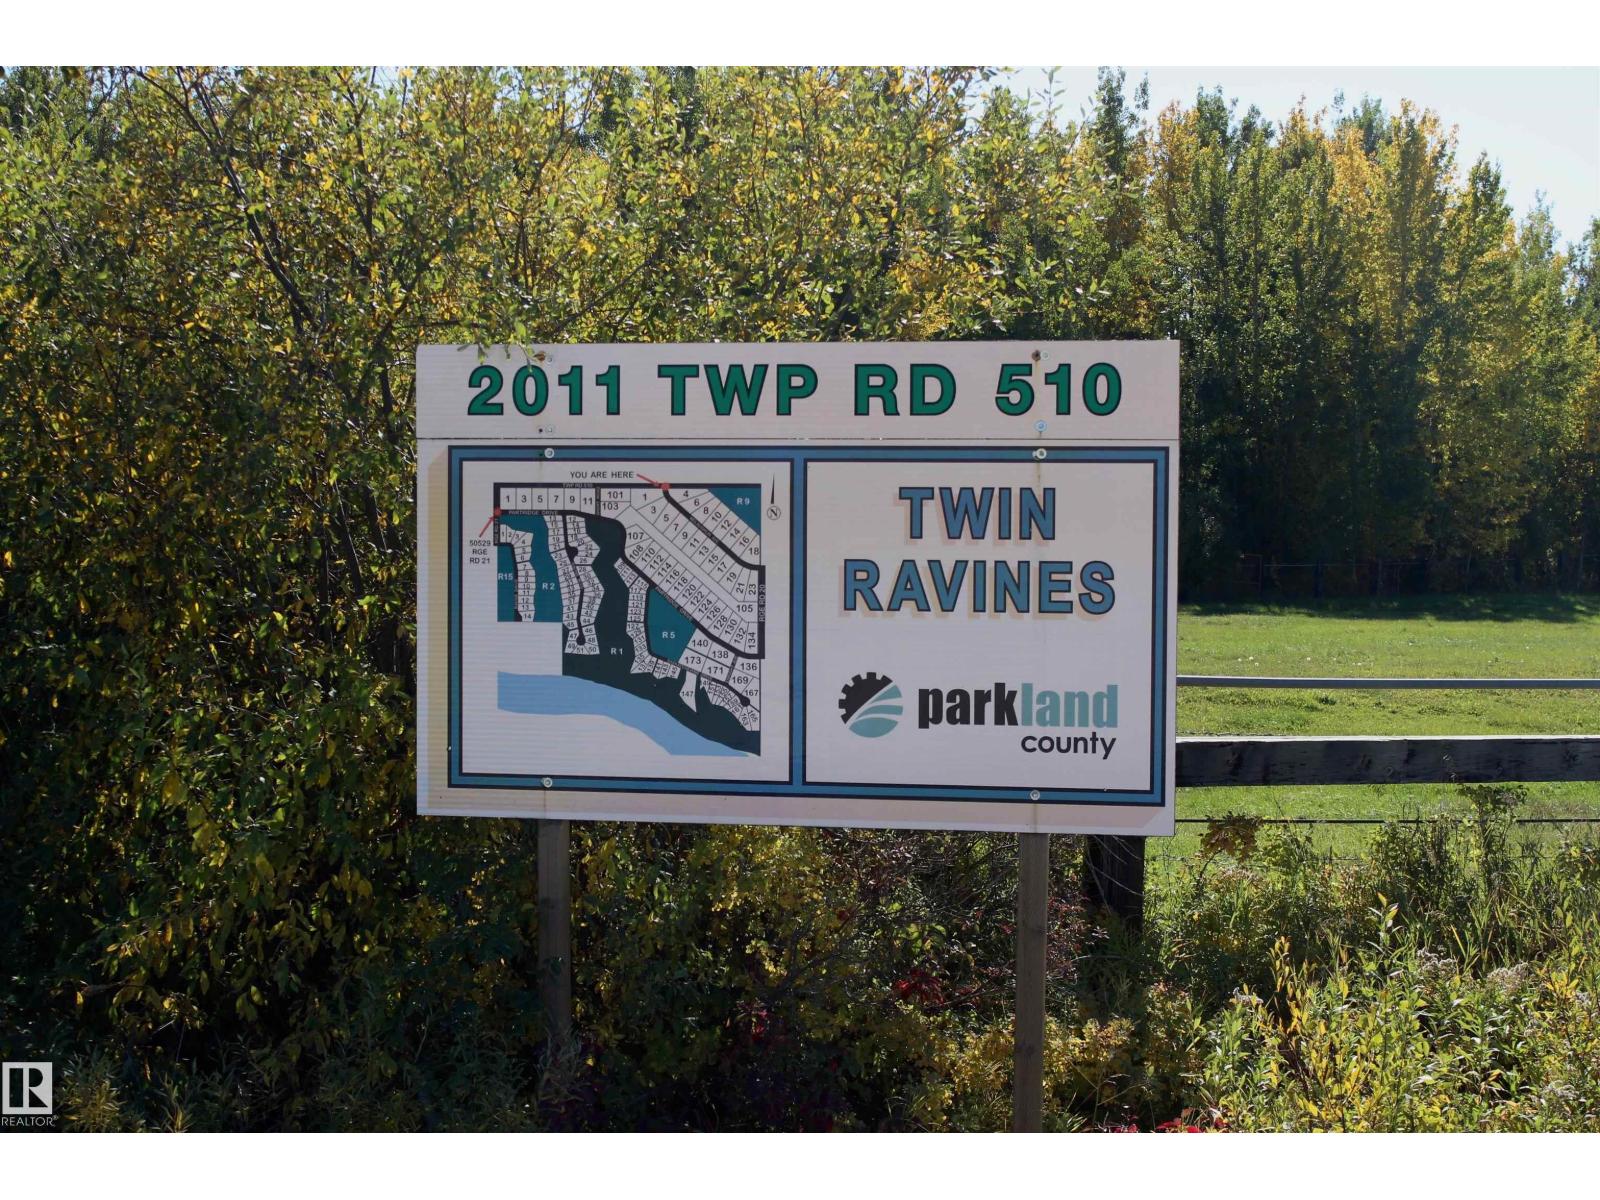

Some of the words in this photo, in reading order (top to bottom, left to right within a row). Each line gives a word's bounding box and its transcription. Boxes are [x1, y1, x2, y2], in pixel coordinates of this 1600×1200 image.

[468, 364, 621, 416] 2011
[658, 364, 818, 416] TWP
[854, 364, 956, 416] RD
[995, 363, 1122, 416] 510
[711, 512, 722, 522] 10
[899, 486, 1058, 540] TWIN
[721, 519, 732, 531] 12
[682, 531, 688, 539] 9
[730, 528, 740, 539] 14
[690, 538, 699, 549] 11
[739, 537, 750, 548] 16
[630, 545, 644, 560] 108
[641, 547, 656, 563] 110
[698, 546, 710, 557] 13
[649, 554, 664, 570] 112
[708, 554, 719, 566] 15
[657, 562, 672, 578] 114
[717, 562, 727, 574] 17
[665, 570, 680, 585] 116
[674, 577, 688, 592] 118
[726, 572, 737, 583] 19
[682, 584, 696, 599] 120
[736, 582, 745, 594] 21
[748, 584, 756, 595] 23
[842, 559, 1116, 614] RAVINES
[691, 592, 704, 606] 122
[699, 599, 712, 614] 124
[707, 606, 720, 621] 126
[714, 616, 728, 631] 128
[725, 619, 737, 635] 130
[734, 628, 746, 644] 132
[919, 682, 1118, 728] parkland
[1021, 732, 1117, 759] county
